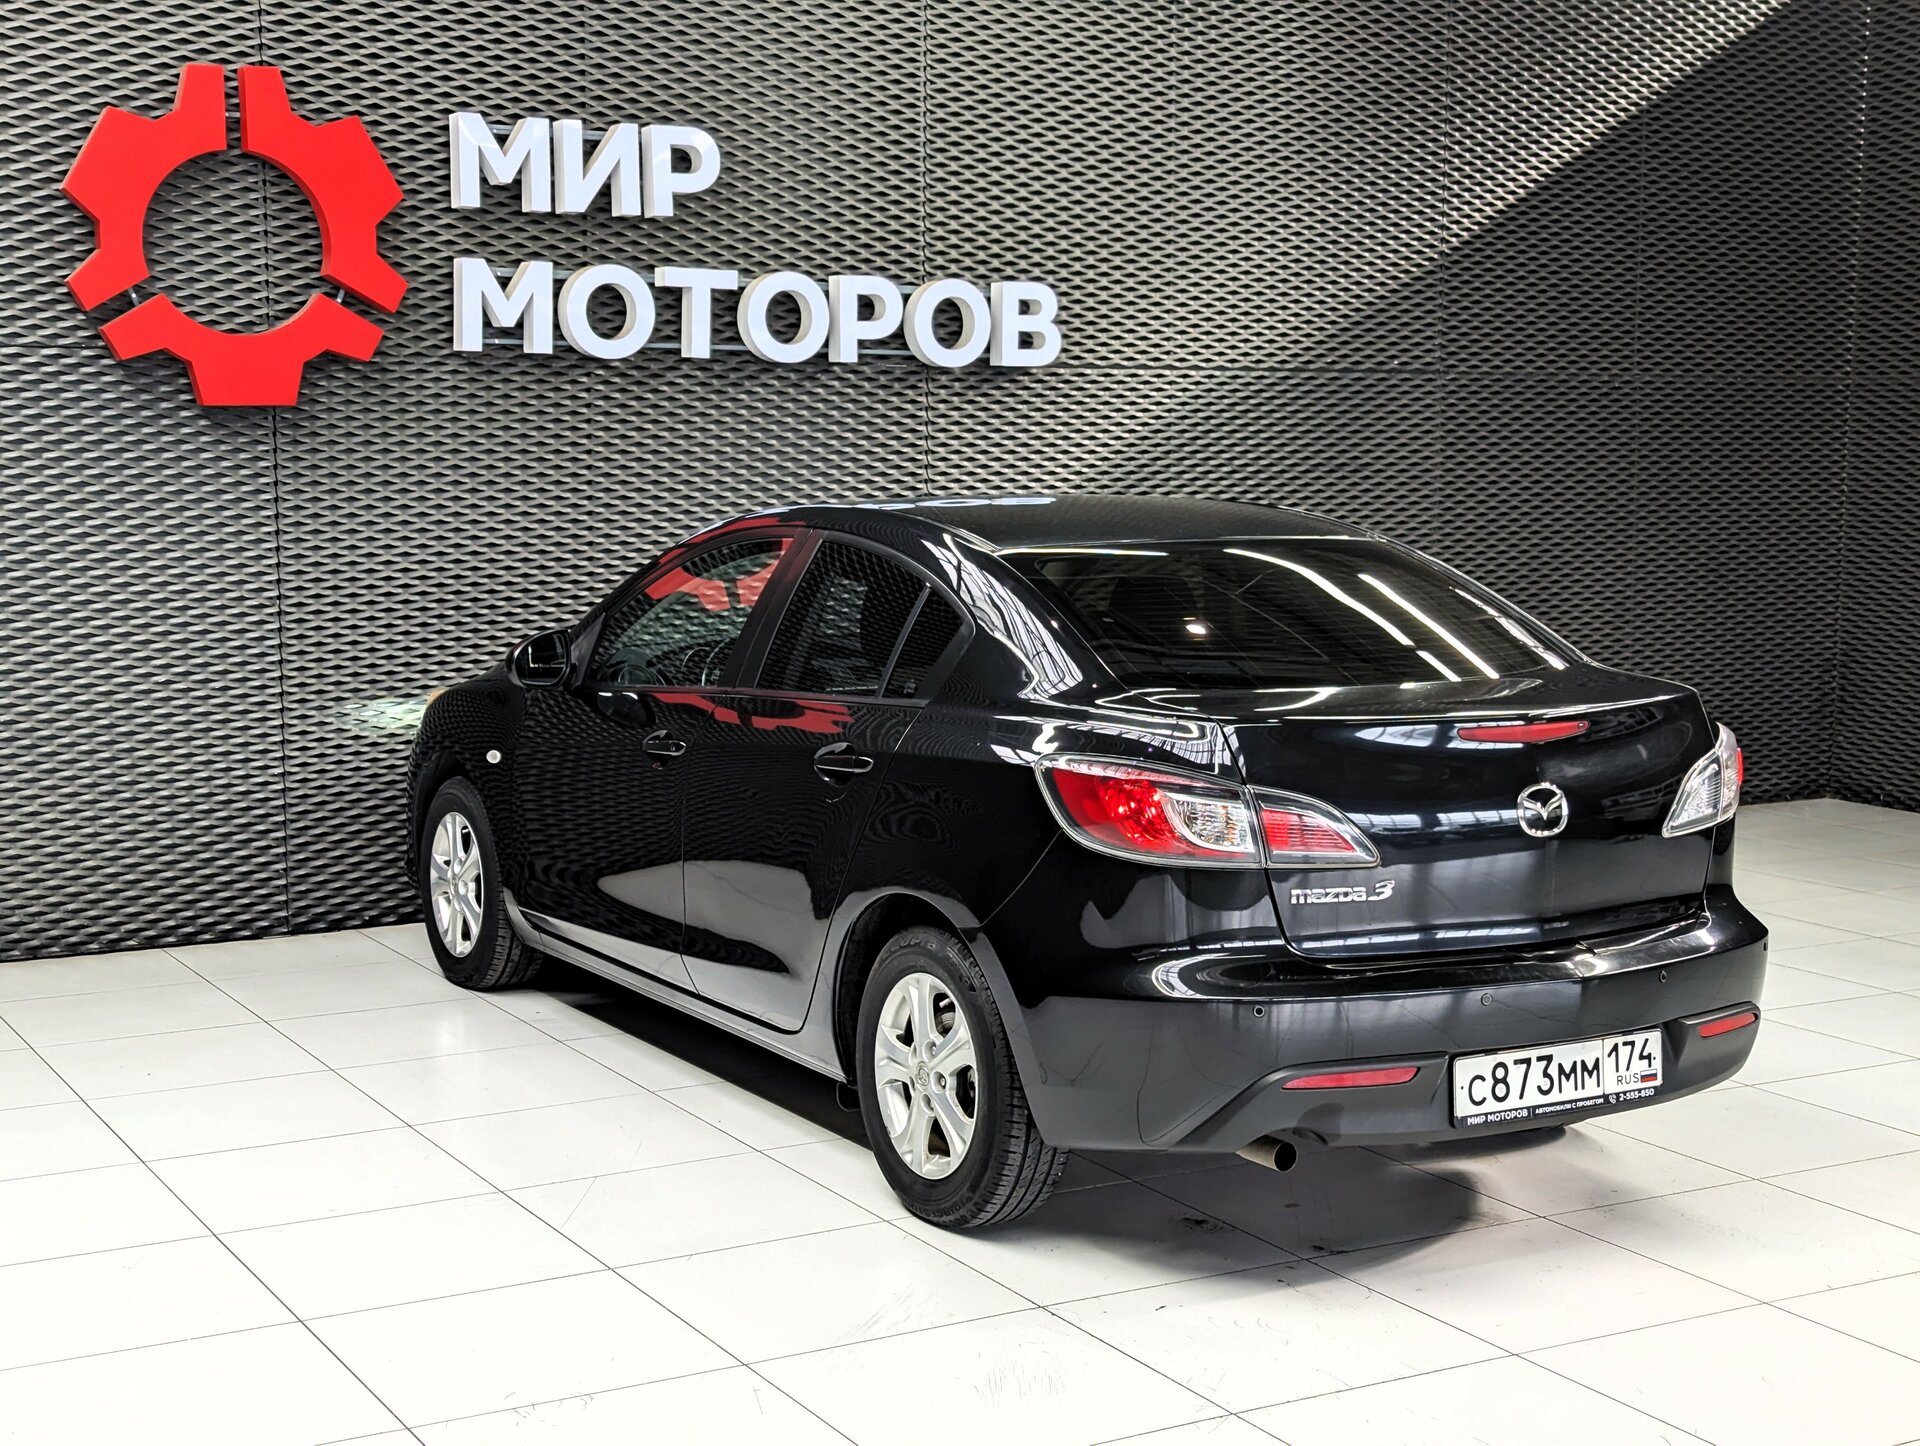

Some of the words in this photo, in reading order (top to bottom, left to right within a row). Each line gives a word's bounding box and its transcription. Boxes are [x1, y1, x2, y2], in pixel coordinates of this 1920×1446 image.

[449, 111, 721, 219] МИР
[452, 257, 1062, 369] МОТОРОВ
[1607, 1038, 1653, 1074] 174
[1616, 1073, 1640, 1086] RUS
[1467, 1115, 1486, 1126] МИР
[1488, 1108, 1528, 1123] МОТОРОВ
[1535, 1102, 1571, 1115] АВТОМОБИЛИ
[1577, 1097, 1604, 1108] ПРОБЕГОМ
